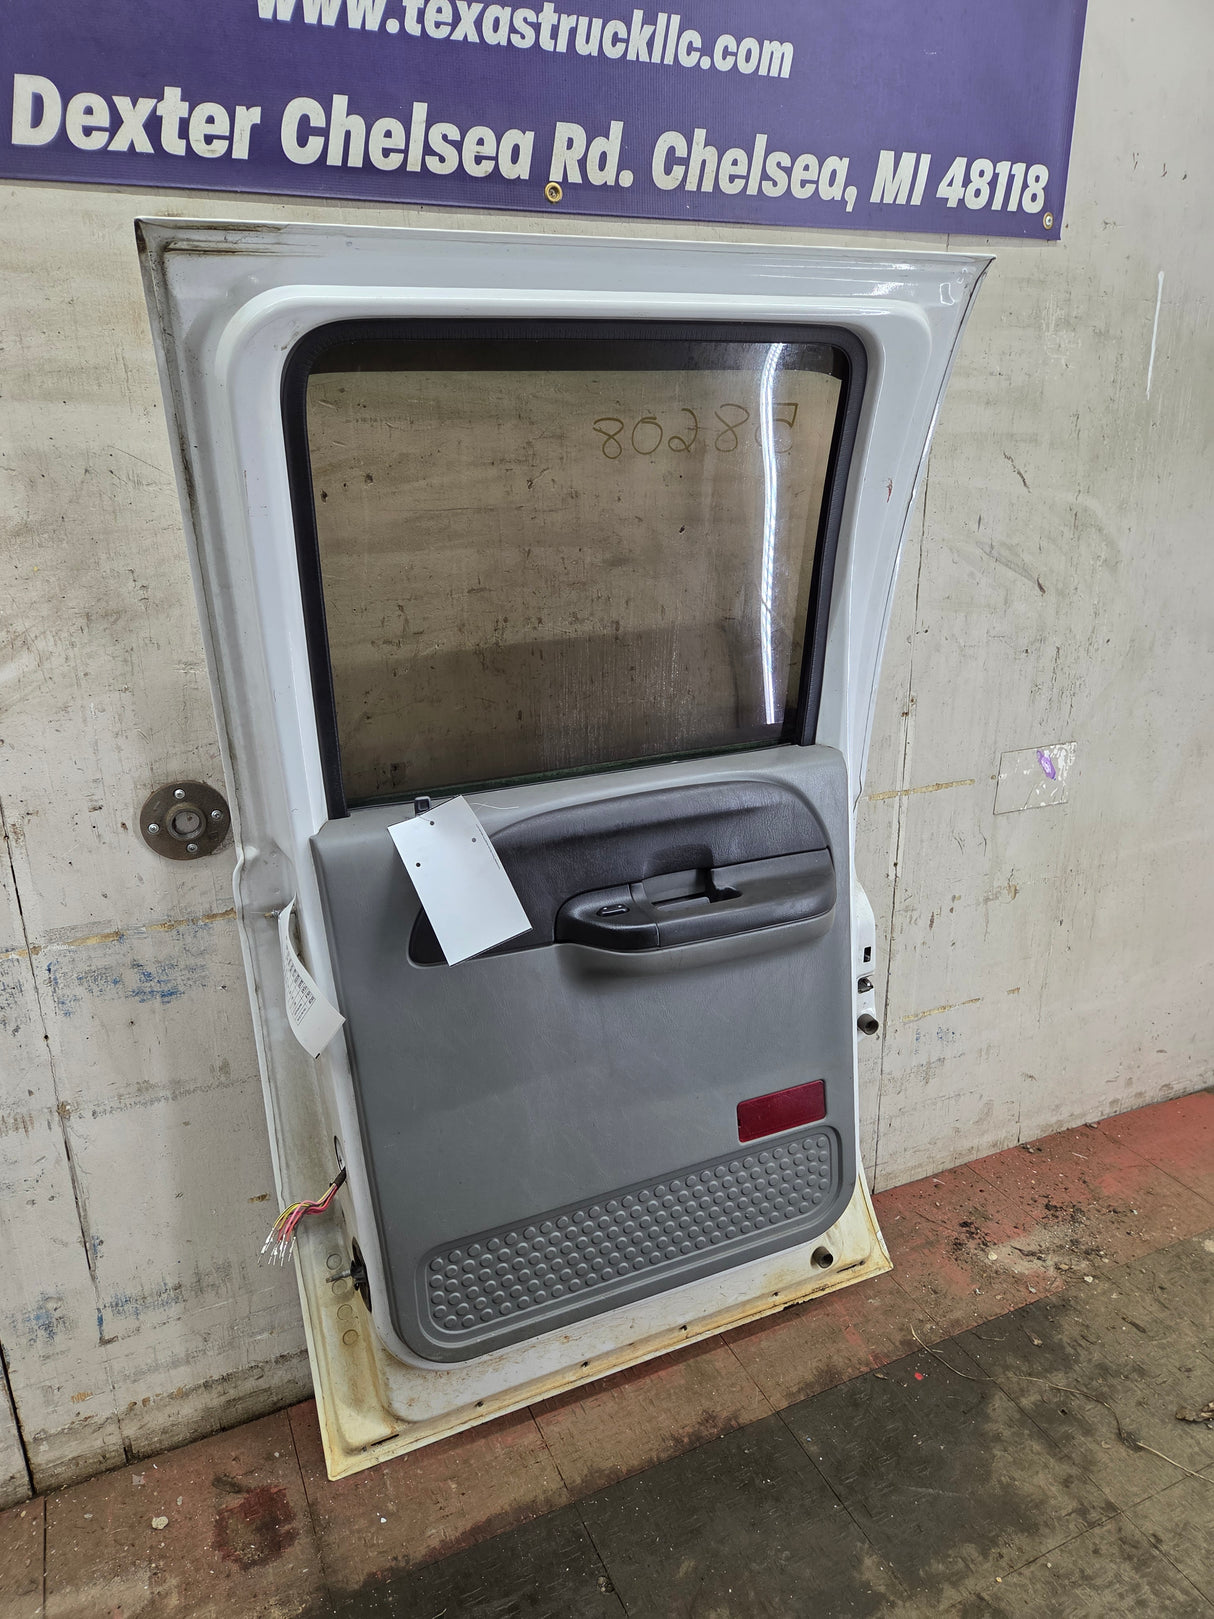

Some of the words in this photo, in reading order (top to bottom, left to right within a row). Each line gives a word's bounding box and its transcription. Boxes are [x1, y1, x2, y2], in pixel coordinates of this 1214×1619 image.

[11, 73, 262, 160] Dexter
[280, 93, 533, 180] Chelsea
[548, 120, 634, 187] Rd.
[651, 128, 858, 213] Chelsea,
[869, 150, 932, 206] MI
[936, 157, 1050, 214] 48118
